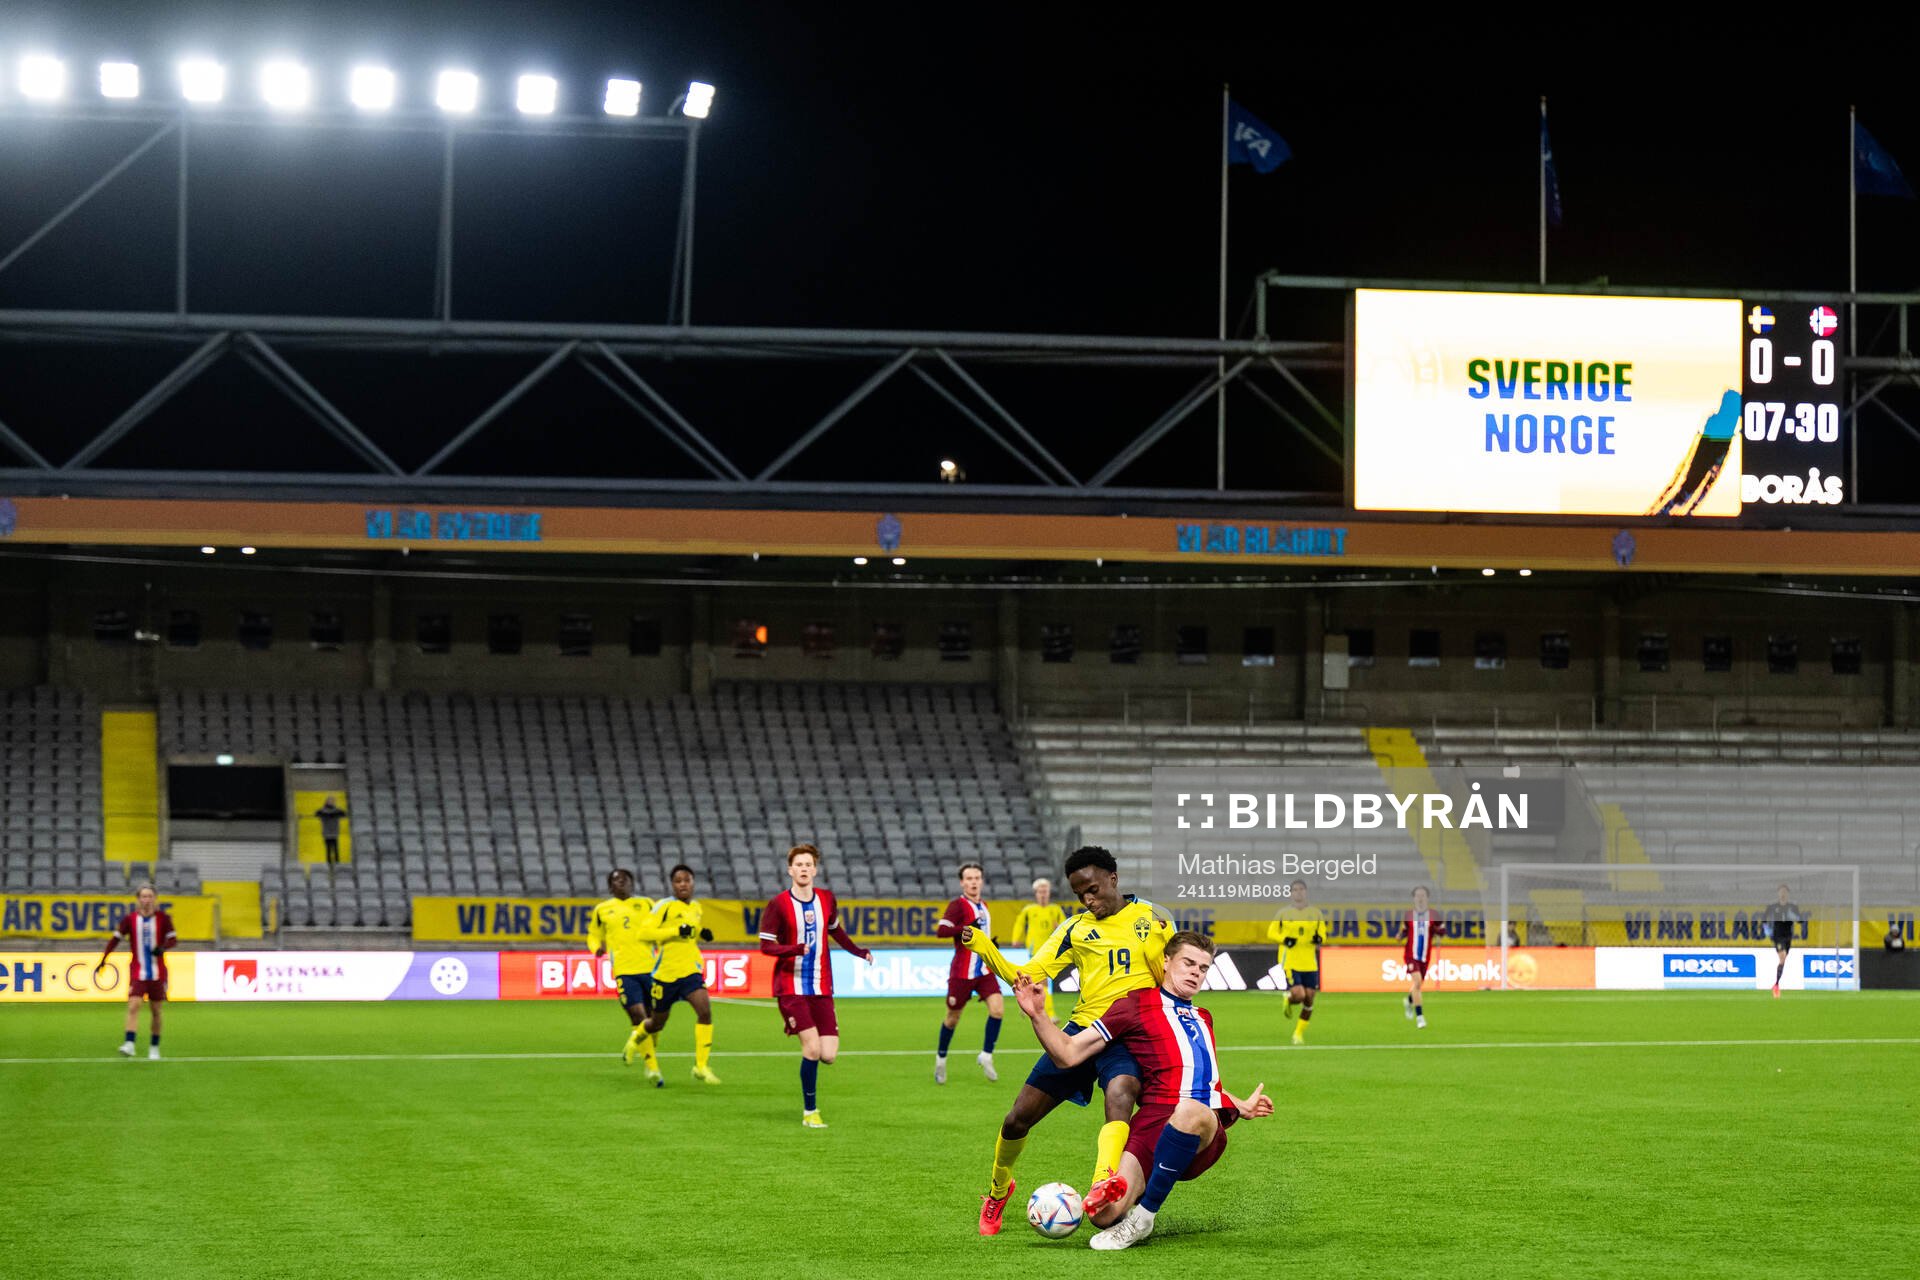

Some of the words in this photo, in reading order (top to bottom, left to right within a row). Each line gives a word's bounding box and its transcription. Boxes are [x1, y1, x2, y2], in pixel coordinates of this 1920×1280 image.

[1750, 338, 1773, 384] 0
[1811, 339, 1835, 386] 0
[1467, 358, 1634, 403] SVERIGE
[1484, 412, 1617, 456] NORGE
[1742, 466, 1844, 505] BORÅS
[3, 899, 43, 931] ÄR
[51, 901, 173, 932] SVER
[458, 904, 488, 934] VI
[492, 902, 532, 933] ÄR
[623, 916, 631, 929] 2
[839, 906, 939, 936] VERIGE
[1624, 911, 1652, 940] VI
[1700, 910, 1811, 940] BLÅGT
[265, 966, 345, 977] SVENSKA
[541, 956, 749, 989] BAUS
[853, 956, 949, 991] Folks
[1108, 948, 1131, 976] 19
[1382, 960, 1501, 981] Swdbank
